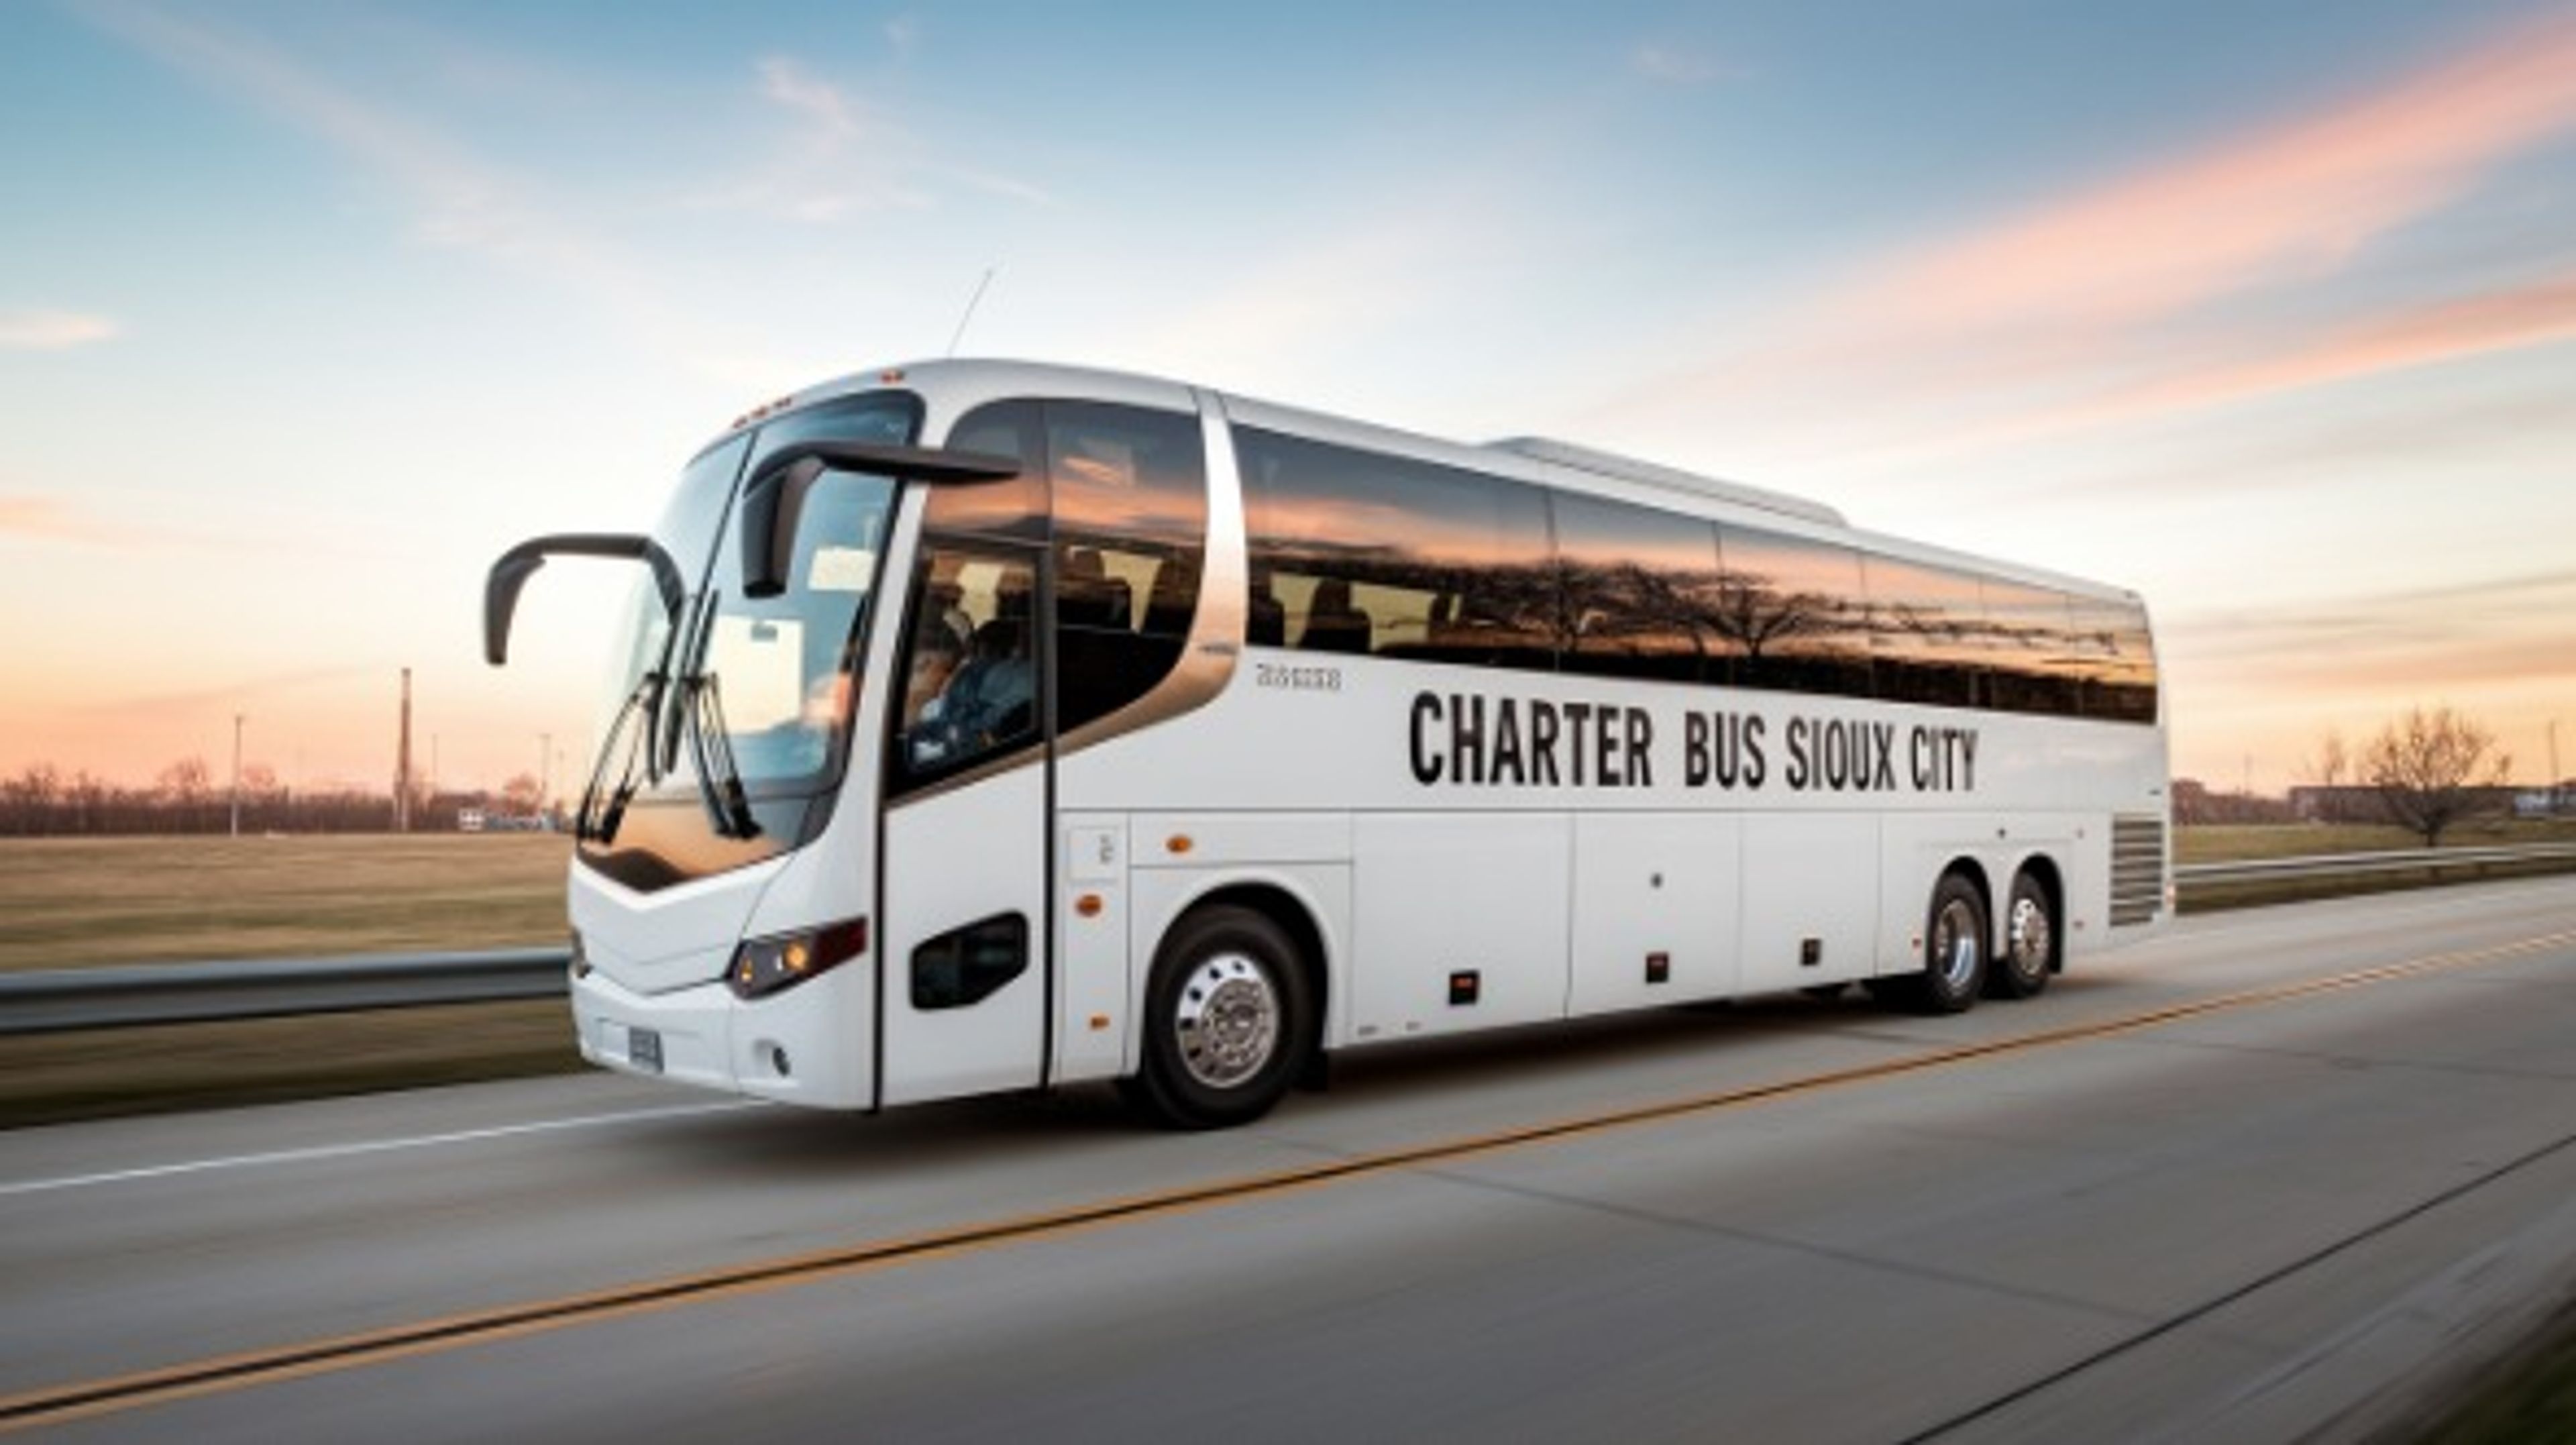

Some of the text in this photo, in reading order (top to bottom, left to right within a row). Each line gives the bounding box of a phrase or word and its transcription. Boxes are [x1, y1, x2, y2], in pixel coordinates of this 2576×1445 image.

[1409, 690, 1978, 792] CHARTER BUS SIOUX CITY
